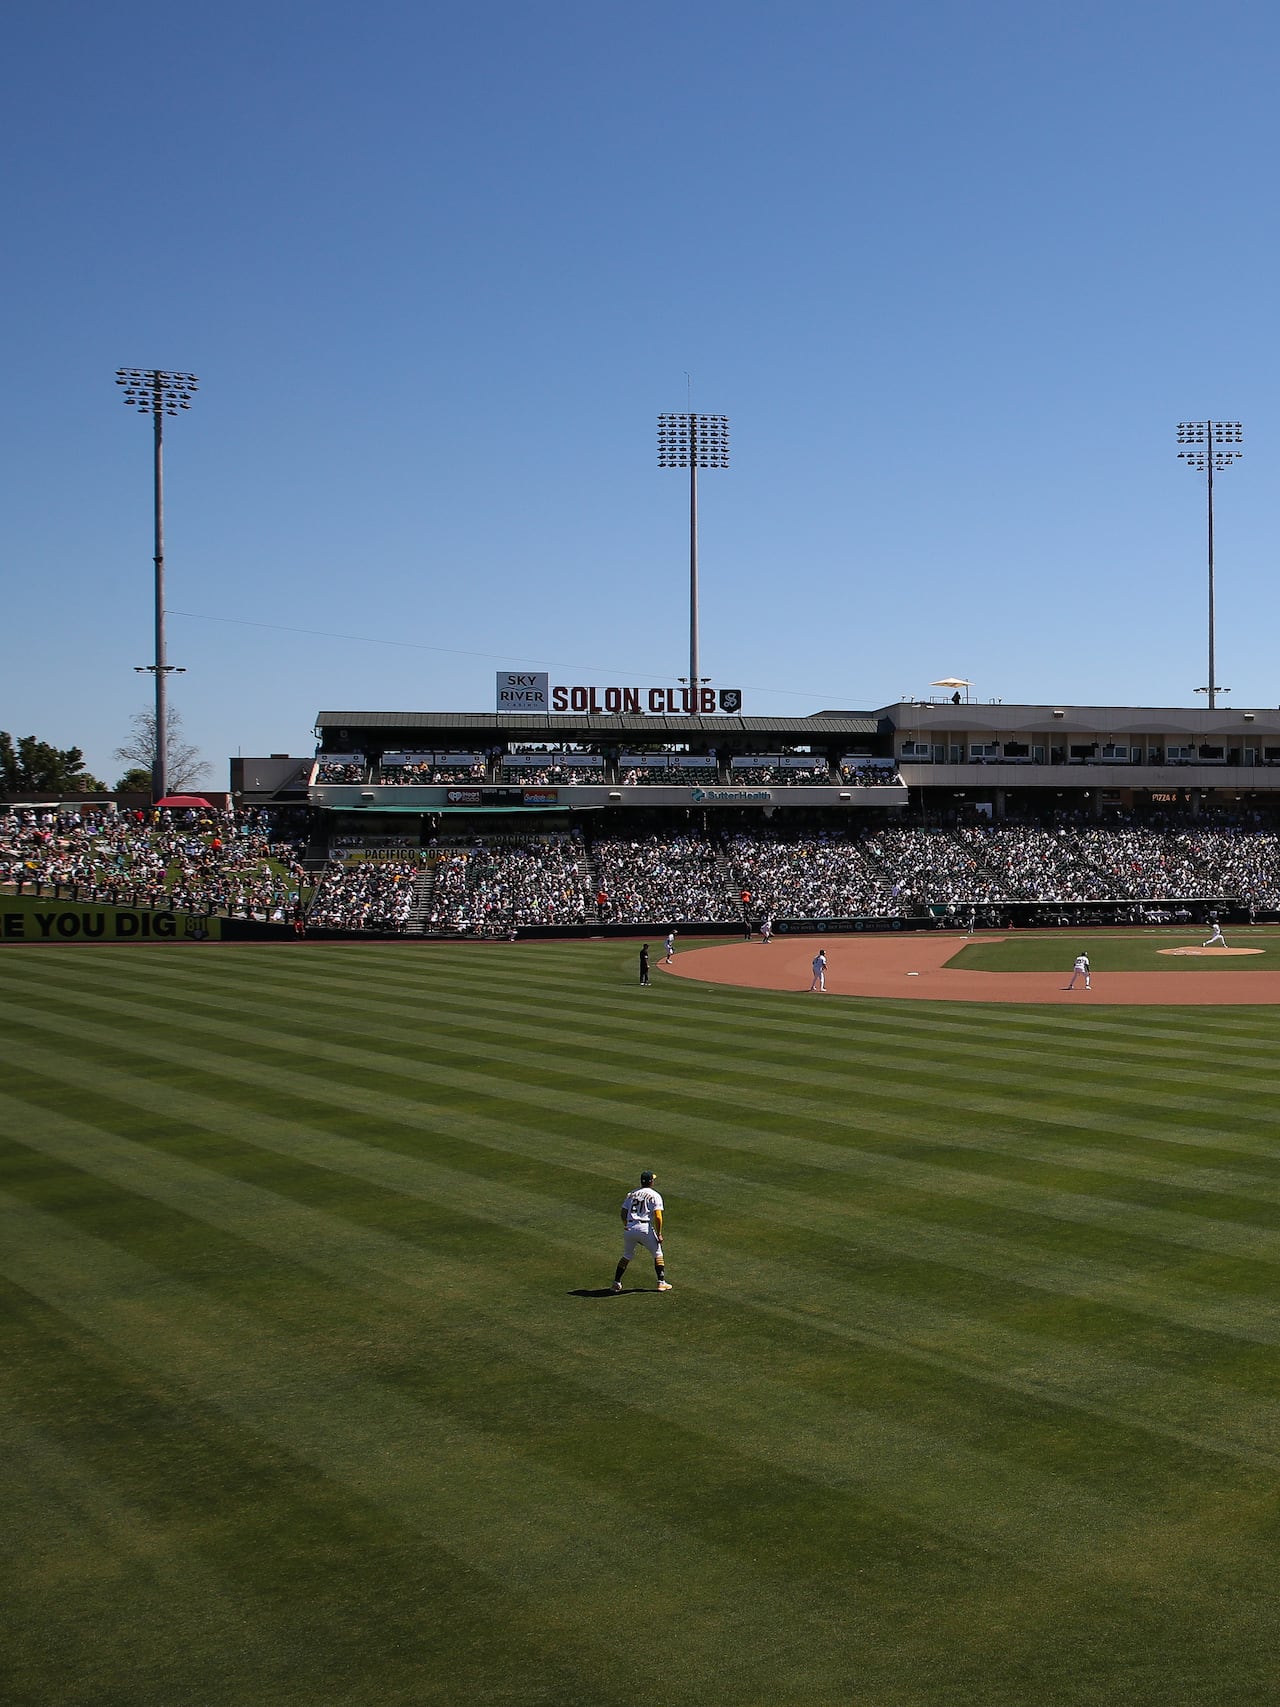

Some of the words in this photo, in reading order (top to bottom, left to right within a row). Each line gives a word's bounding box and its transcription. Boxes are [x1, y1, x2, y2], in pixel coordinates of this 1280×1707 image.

[508, 676, 536, 687] SKY
[501, 691, 544, 703] RIVER
[553, 687, 639, 713] SOLON
[649, 688, 716, 714] CLUB
[1152, 793, 1170, 802] PIZZA
[365, 849, 415, 861] PACIFICO
[34, 913, 105, 937] YOU
[116, 913, 177, 937] DIG
[185, 916, 208, 933] 811
